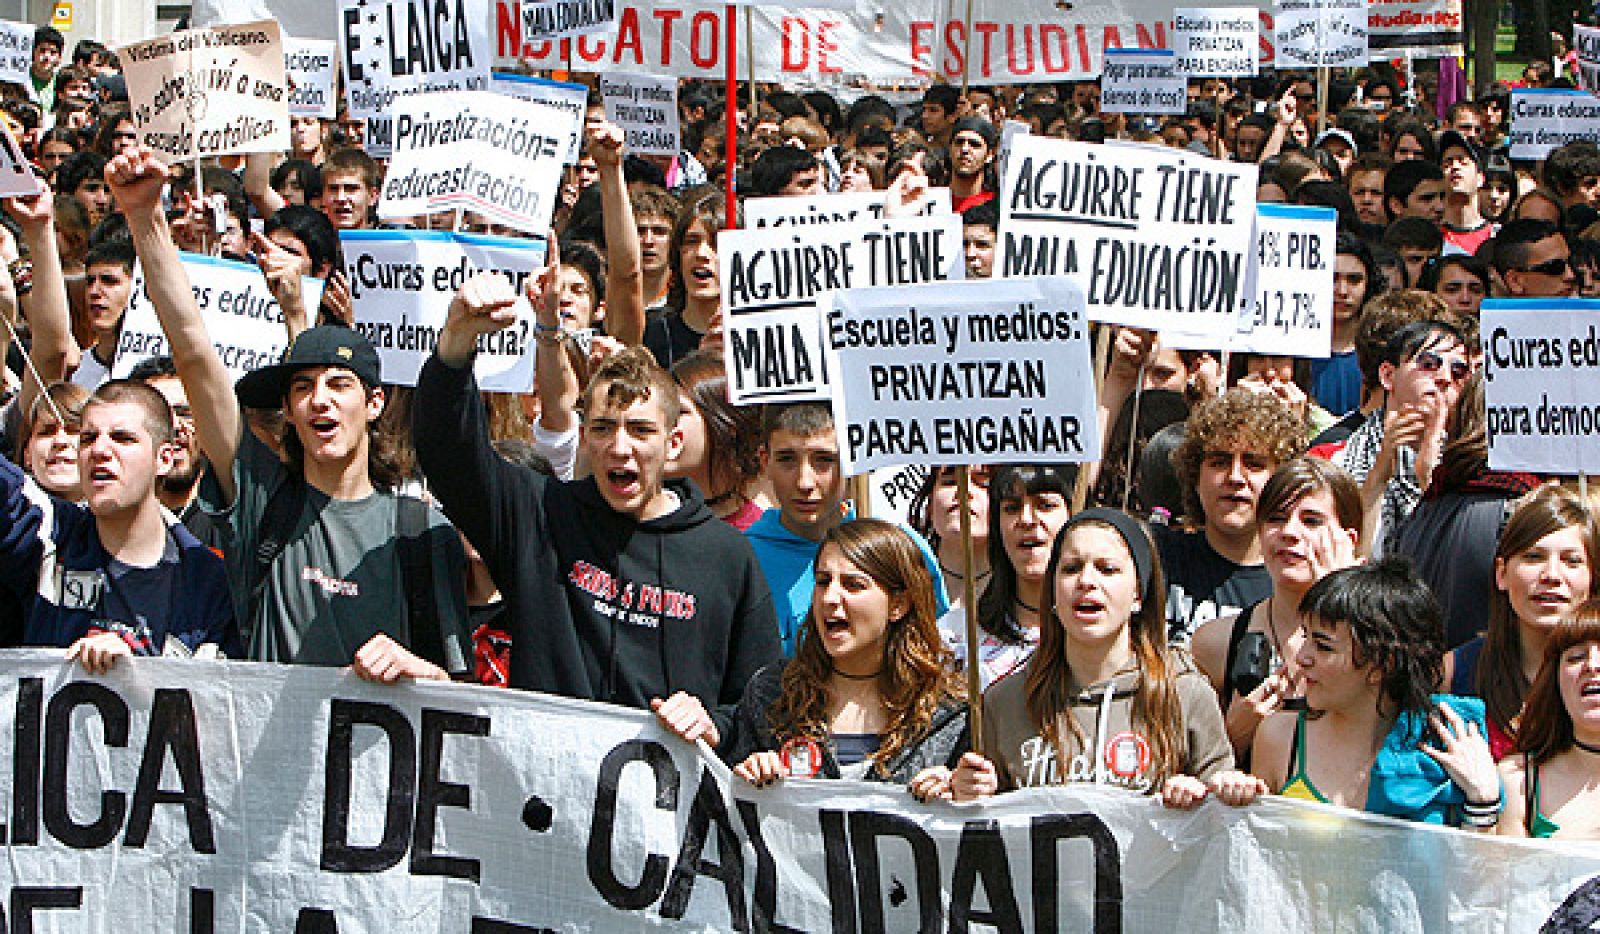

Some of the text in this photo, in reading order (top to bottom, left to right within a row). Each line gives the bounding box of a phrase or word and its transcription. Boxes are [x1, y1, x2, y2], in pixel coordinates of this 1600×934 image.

[344, 0, 474, 81] E LAICA
[781, 16, 844, 73] DE
[1010, 152, 1146, 222] AGUIRRE
[1155, 159, 1242, 225] TIENE
[349, 253, 425, 300] ¿Curas
[728, 224, 948, 308] AGUIRRE TIENE
[1287, 231, 1326, 270] PIB.
[729, 323, 815, 391] MALA
[827, 302, 1081, 355] Escuela y medios:
[1484, 326, 1565, 383] ¿Curas
[869, 359, 1046, 401] PRIVATIZAN
[846, 407, 1084, 463] PARA ENGAÑAR
[1487, 403, 1532, 450] para
[0, 676, 1125, 934] ICA DE CALIDAD
